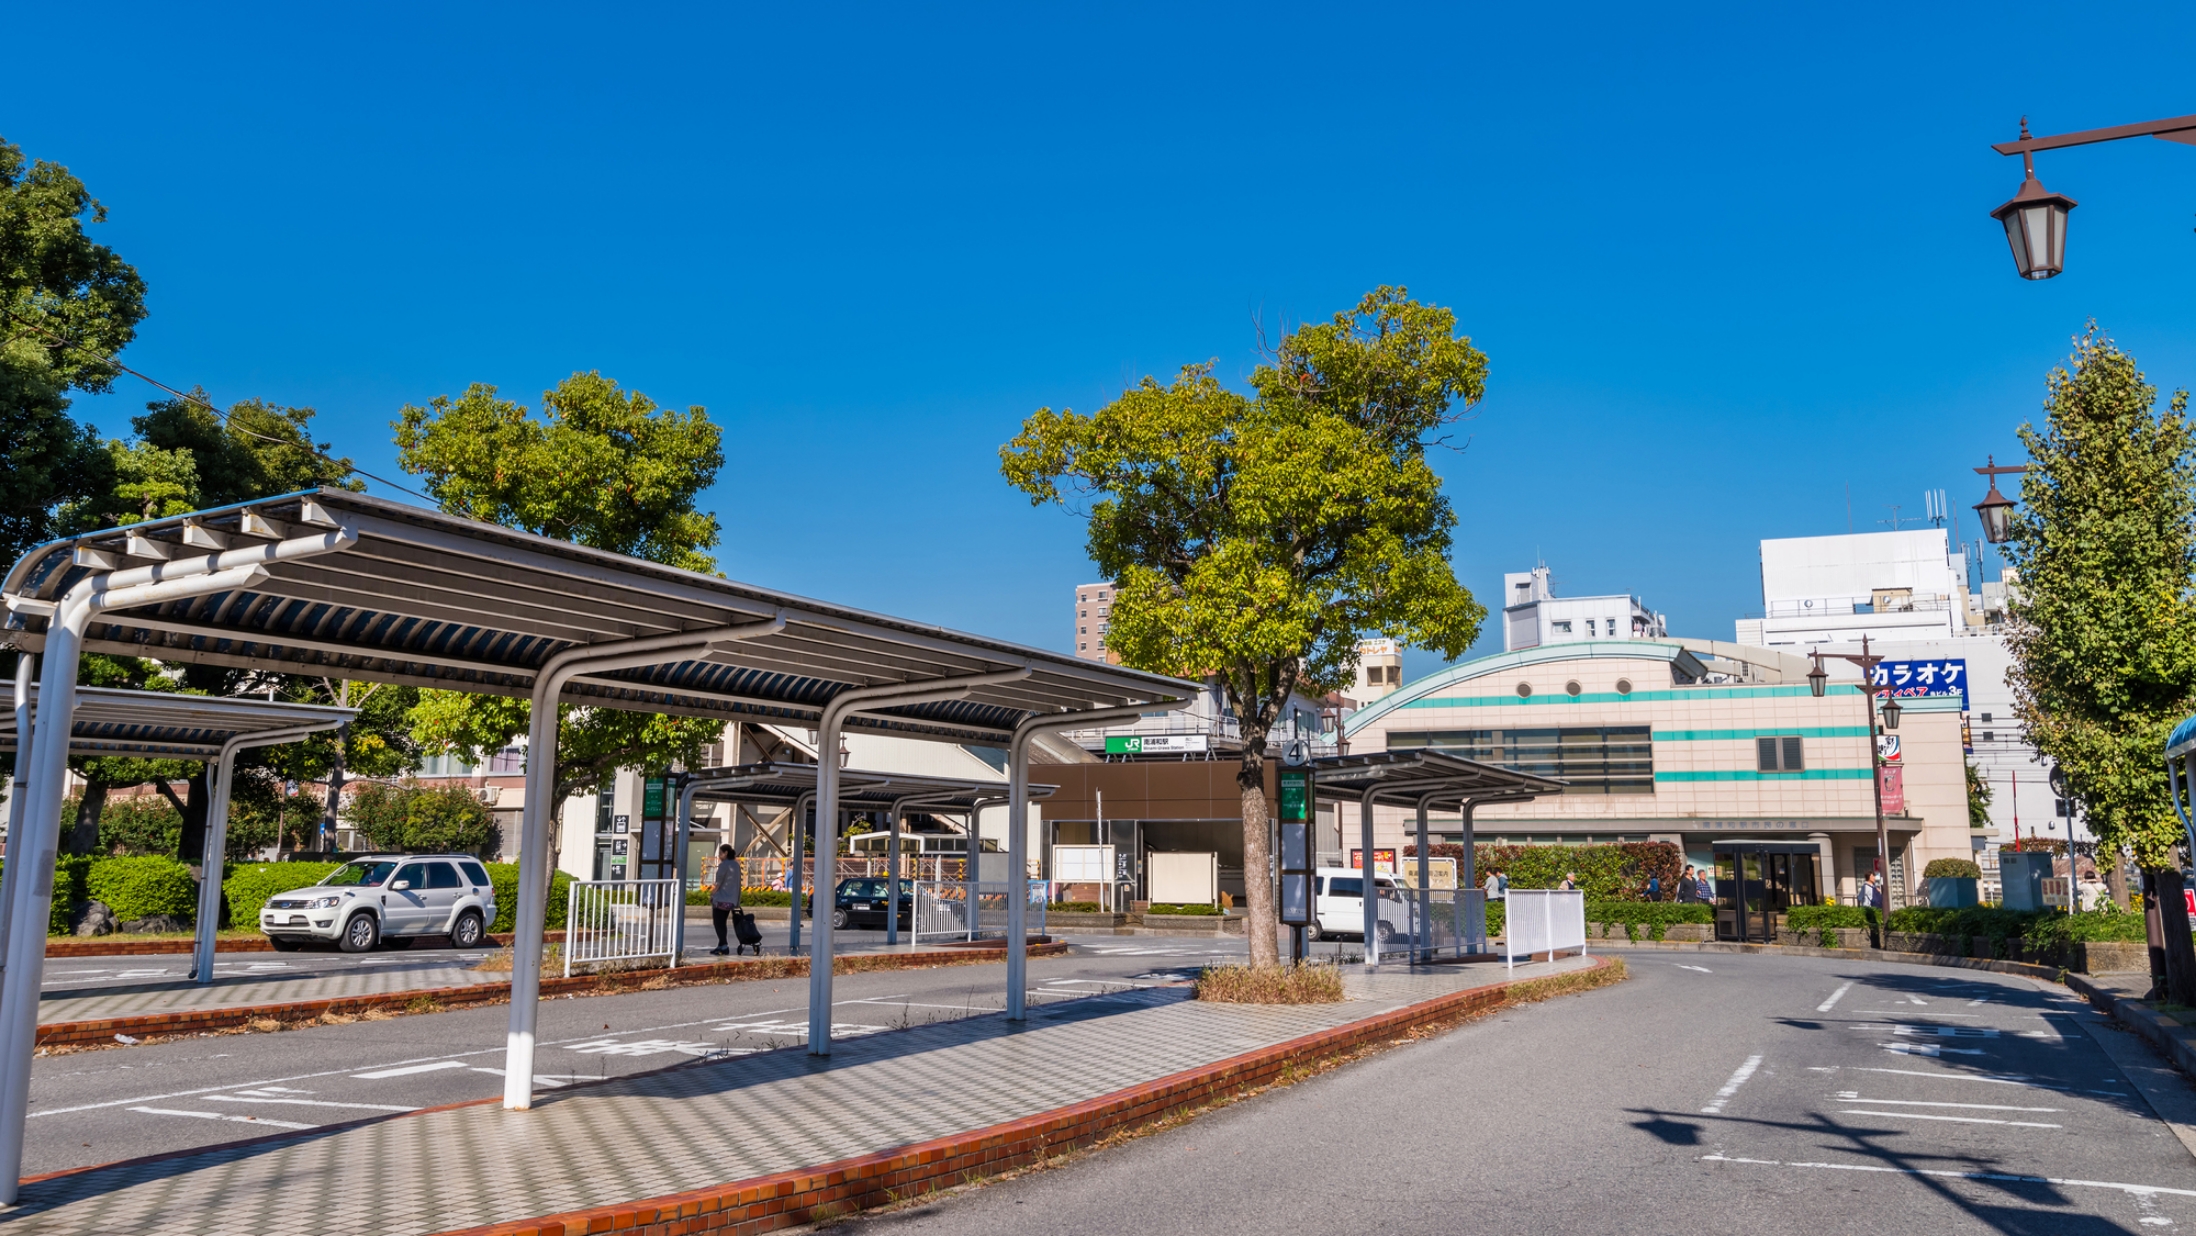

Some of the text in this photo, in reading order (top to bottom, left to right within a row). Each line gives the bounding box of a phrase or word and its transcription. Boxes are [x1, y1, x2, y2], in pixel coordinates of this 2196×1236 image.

[1870, 663, 1963, 685] カラオケ
[1125, 738, 1140, 748] JR
[1288, 743, 1301, 761] 4
[1702, 821, 1809, 829] 南浦和駅市民の窓口
